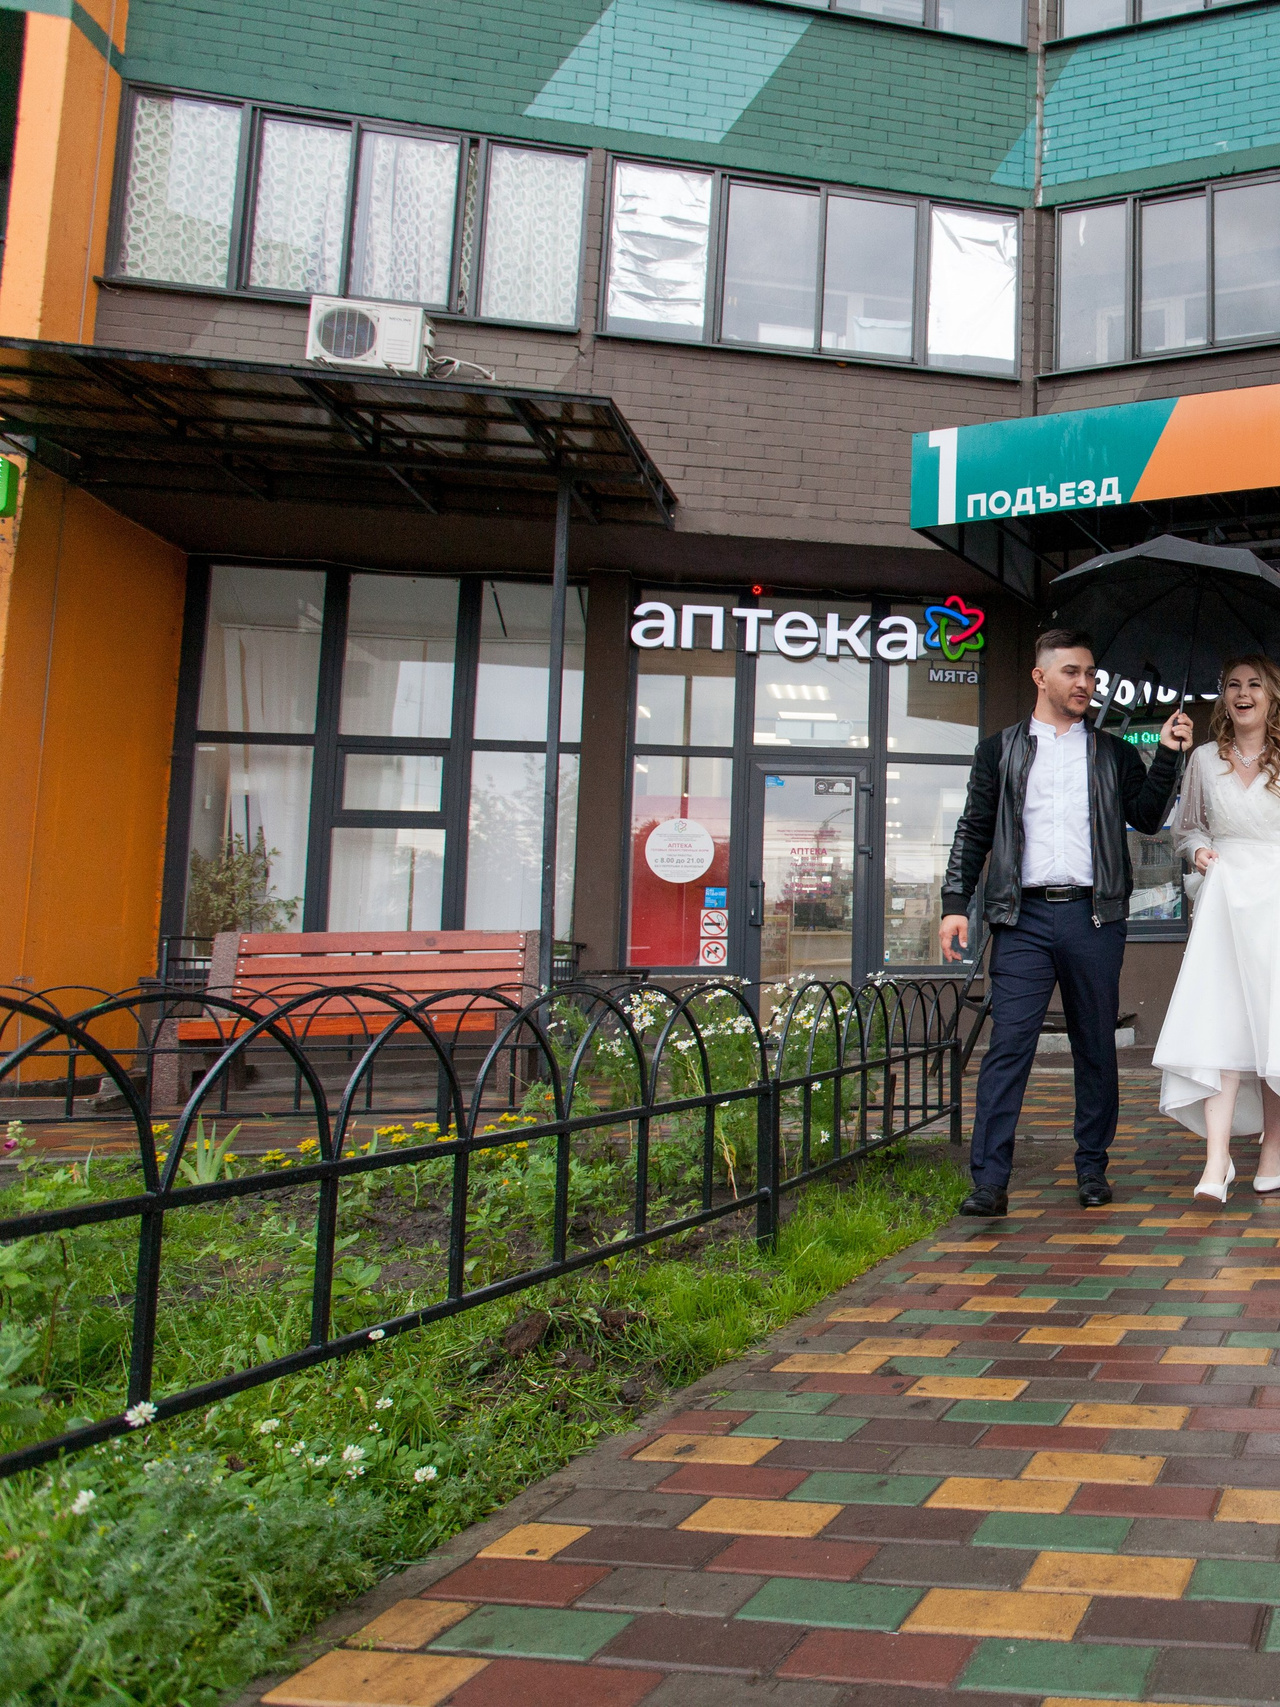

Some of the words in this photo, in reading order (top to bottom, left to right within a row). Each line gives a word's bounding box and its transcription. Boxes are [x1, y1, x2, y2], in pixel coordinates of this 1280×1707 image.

[928, 427, 958, 525] 1
[967, 476, 1122, 517] ПОДЪЕЗД
[630, 601, 919, 662] аптека
[929, 669, 978, 684] мята
[790, 847, 828, 855] АПТЕКА
